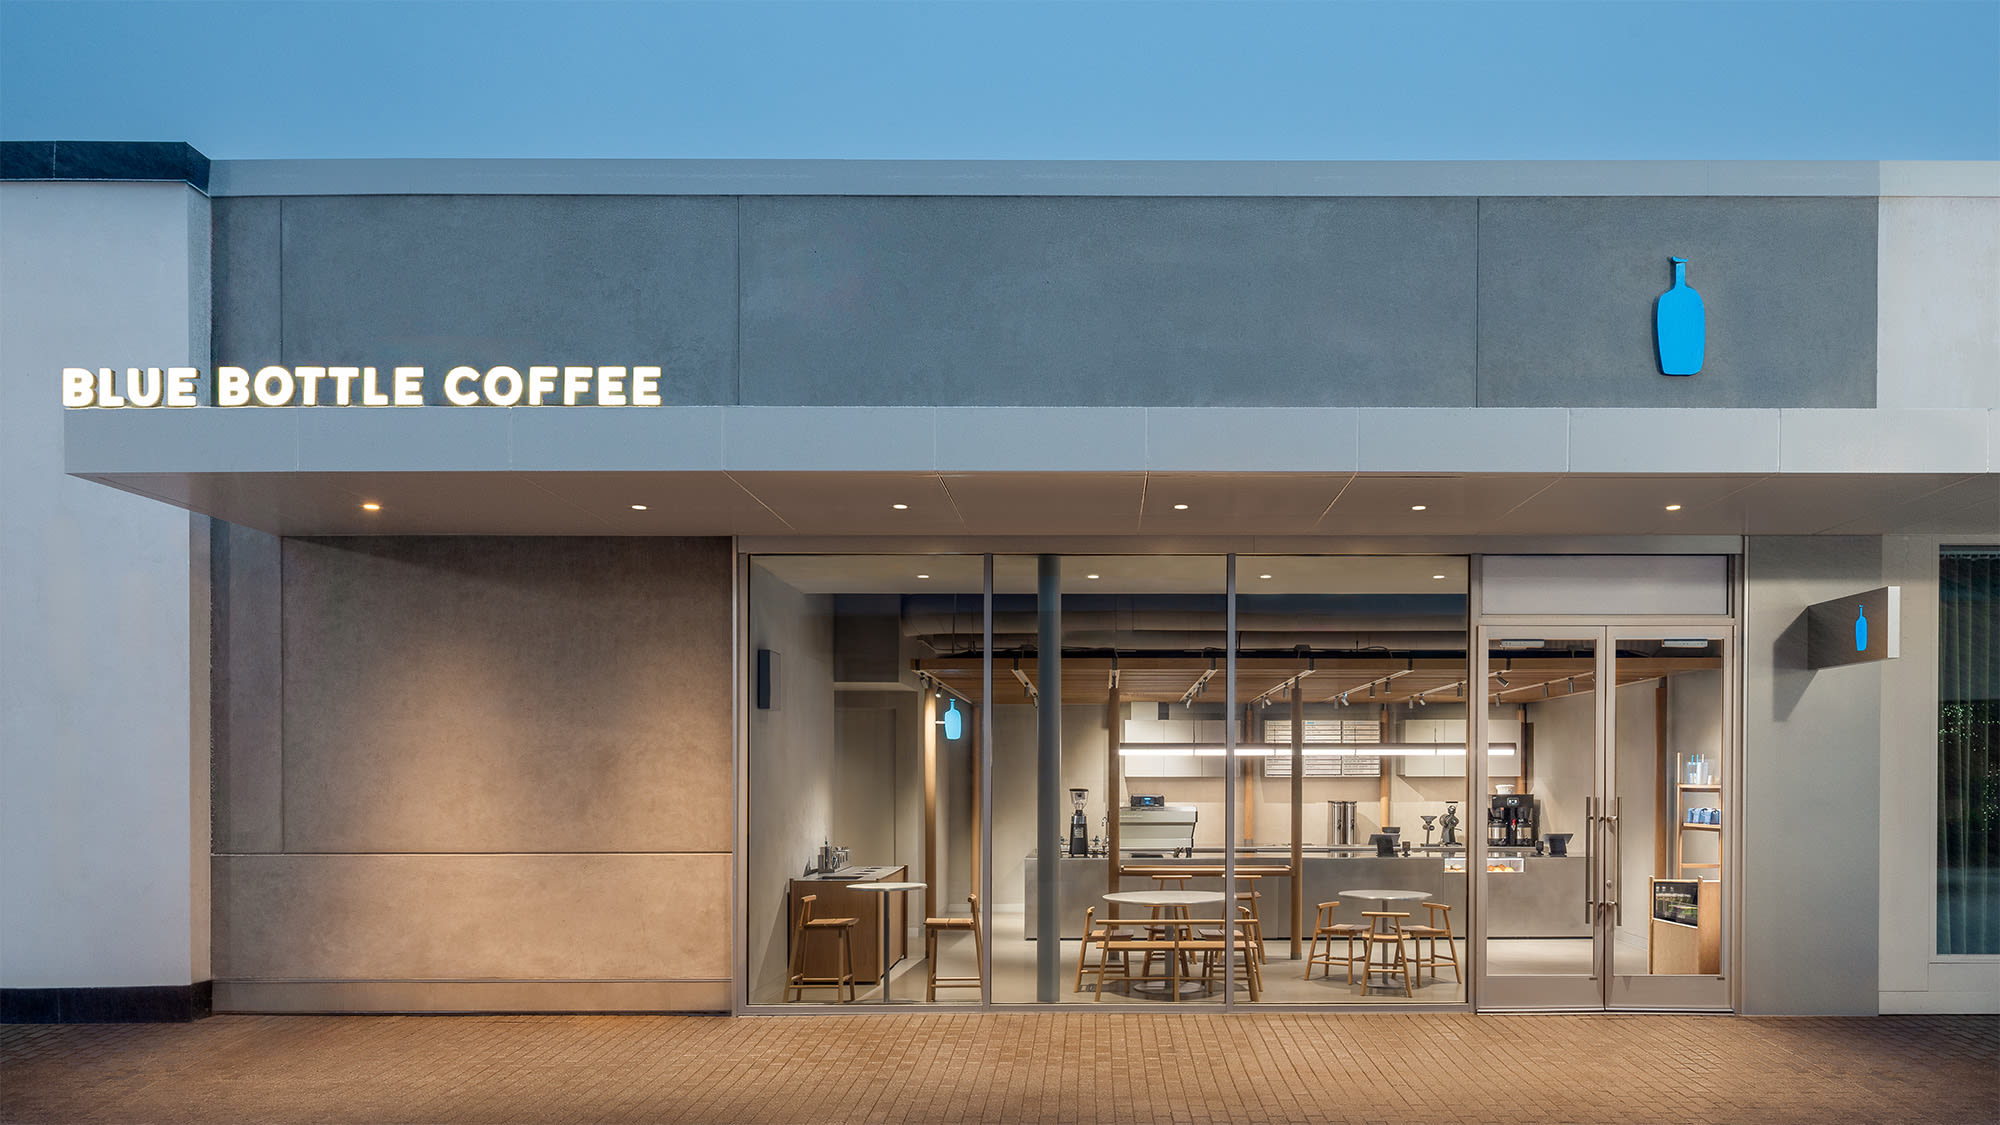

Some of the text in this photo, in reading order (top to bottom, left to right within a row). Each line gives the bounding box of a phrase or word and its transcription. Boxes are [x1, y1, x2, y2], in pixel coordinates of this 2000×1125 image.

[63, 366, 662, 409] BLUE BOTTLE COFFEE
